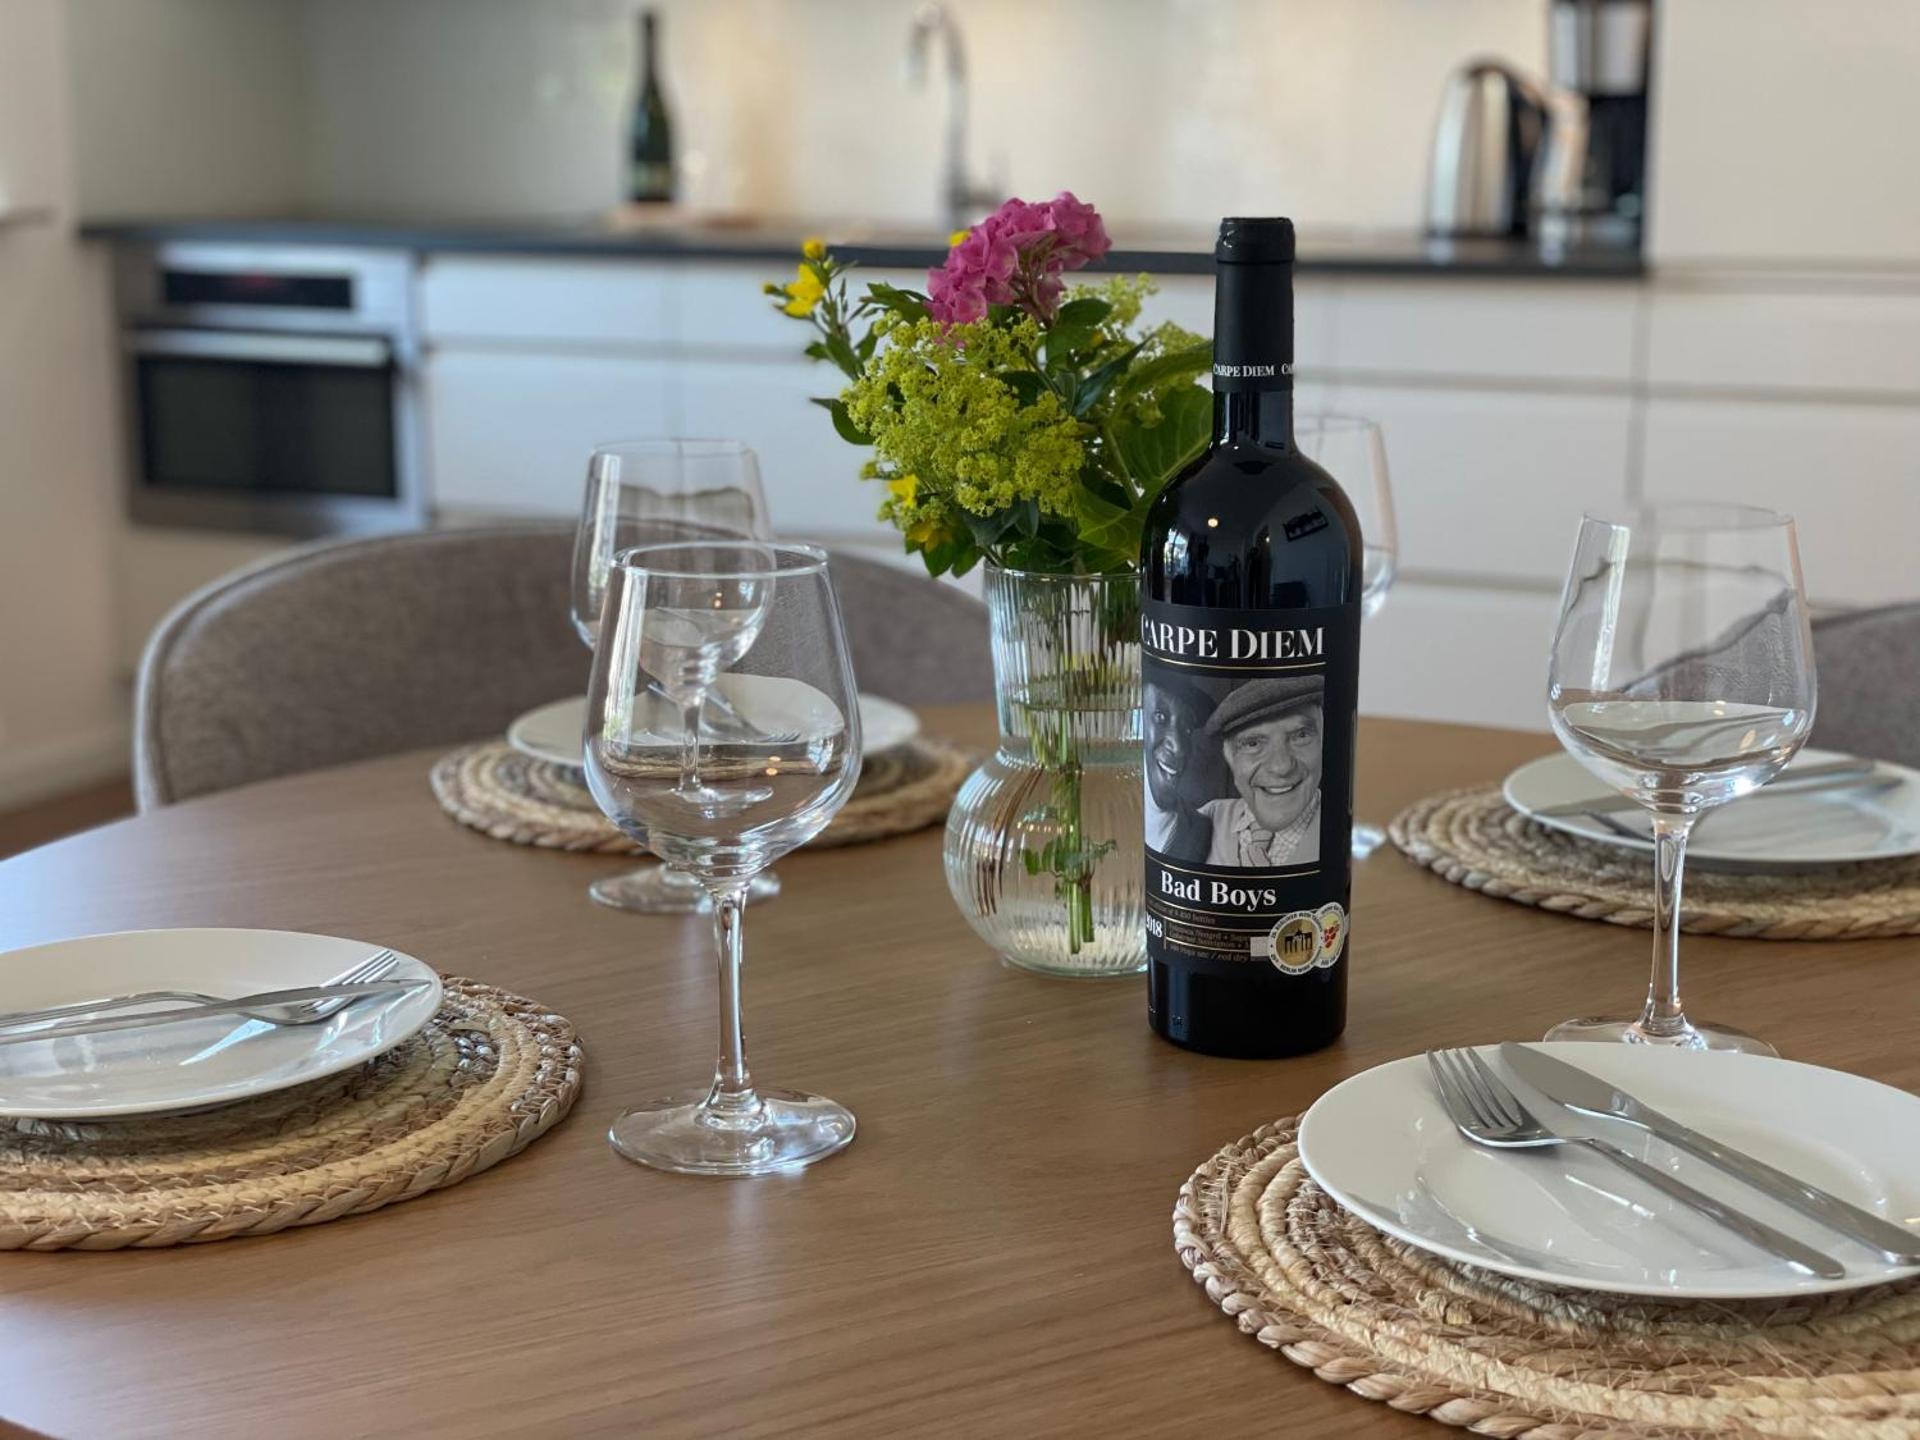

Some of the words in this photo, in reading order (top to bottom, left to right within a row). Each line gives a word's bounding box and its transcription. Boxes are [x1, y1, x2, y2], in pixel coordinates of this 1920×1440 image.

[1212, 362, 1241, 377] CARPE
[1242, 365, 1275, 378] DIEM
[1141, 612, 1219, 659] CARPE
[1229, 626, 1326, 659] DIEM
[1161, 869, 1201, 902] Bad
[1210, 881, 1277, 912] Boys
